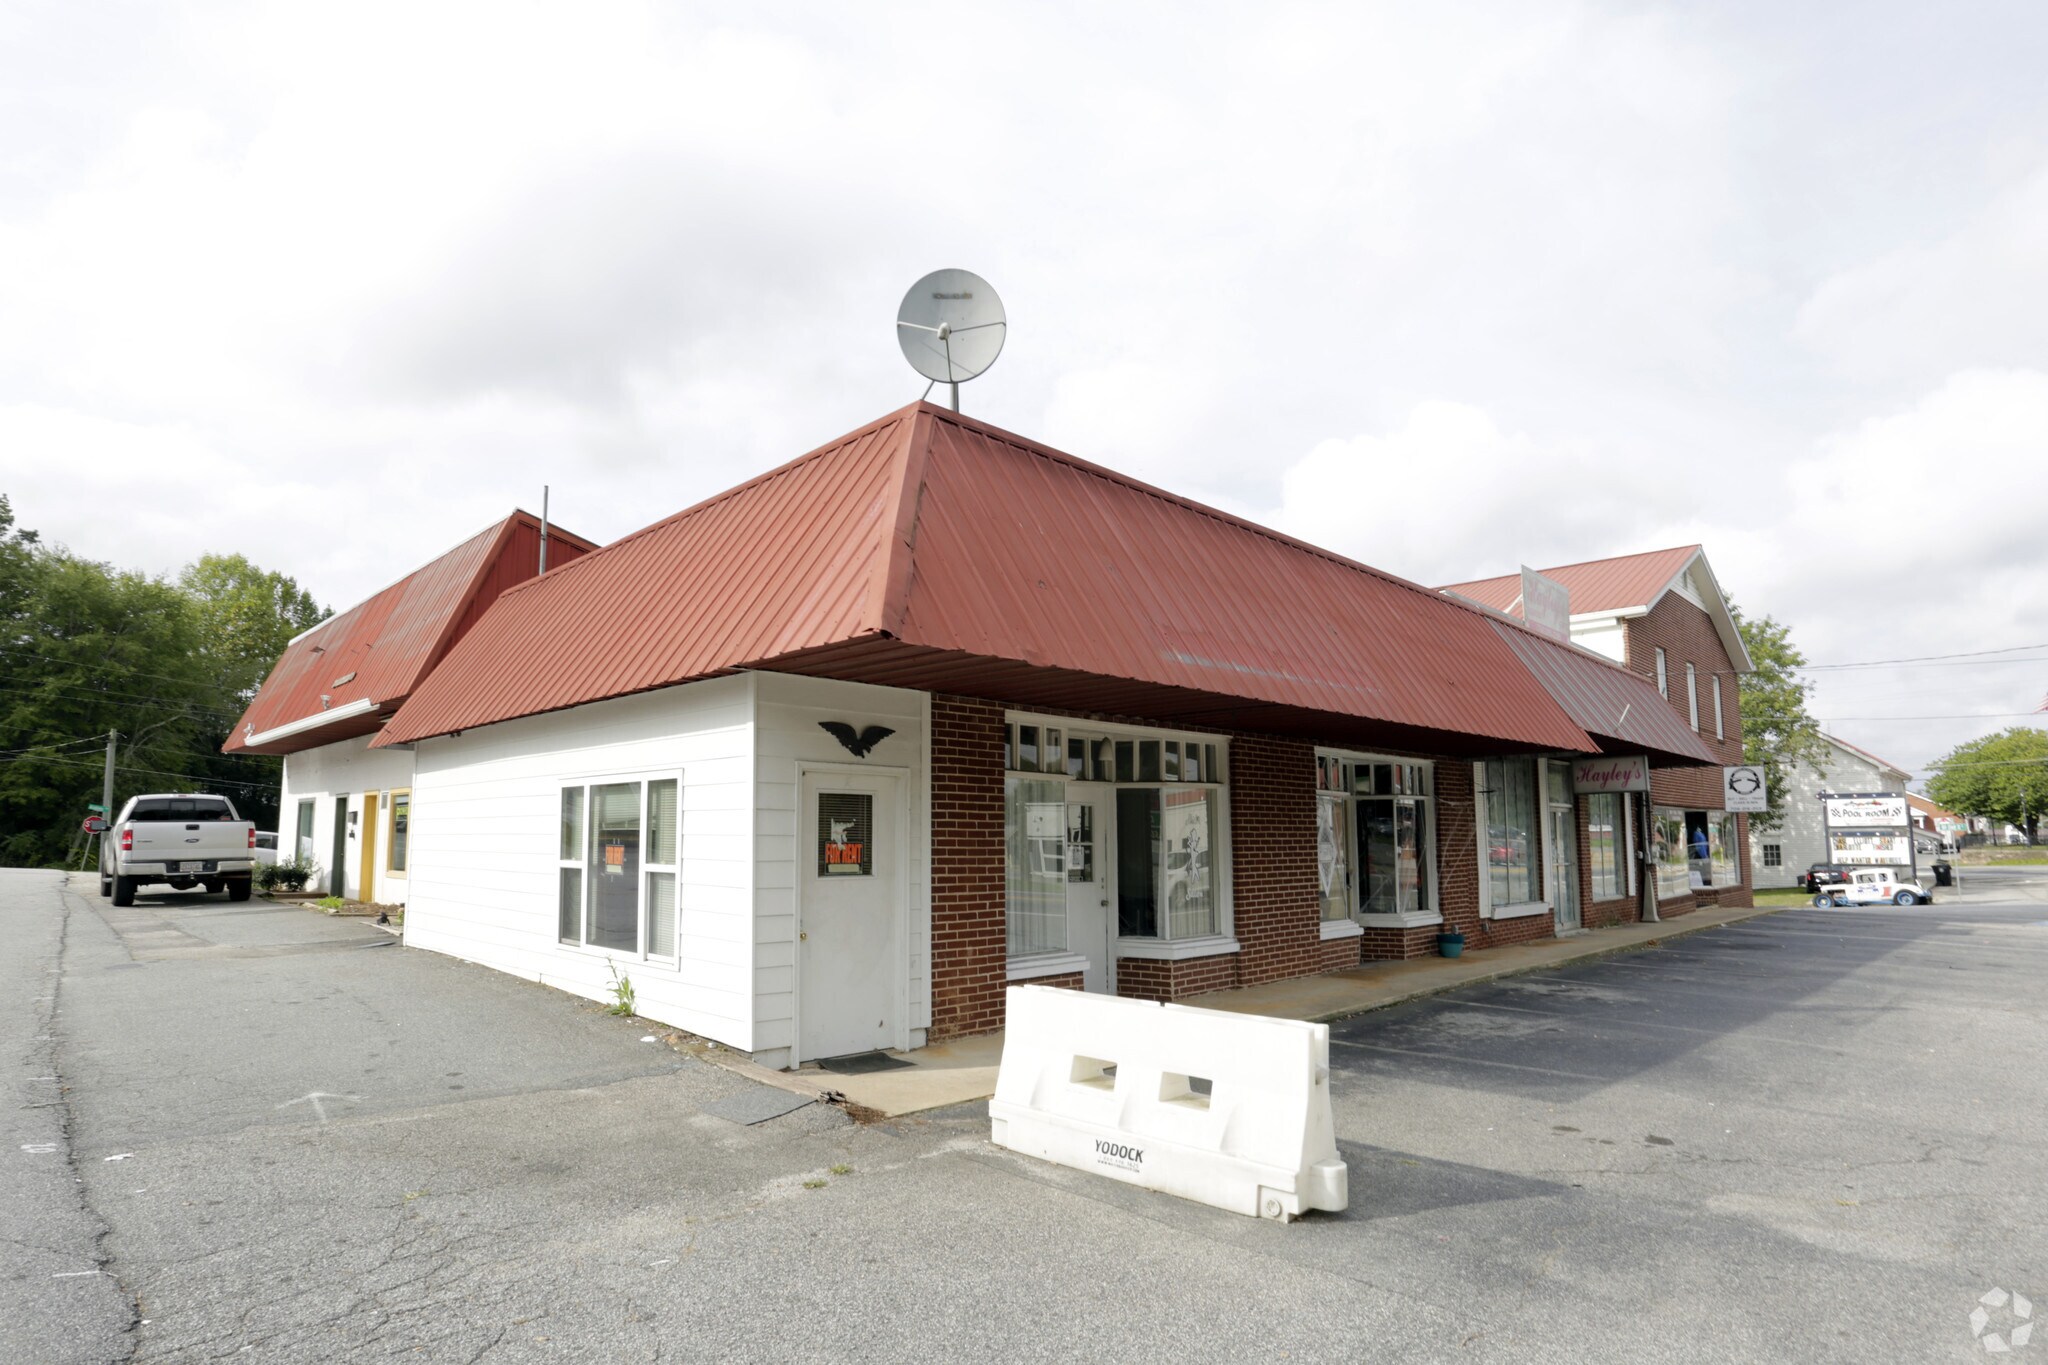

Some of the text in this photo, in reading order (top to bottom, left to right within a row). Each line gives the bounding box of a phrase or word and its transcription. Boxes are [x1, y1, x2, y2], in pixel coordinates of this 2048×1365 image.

[1576, 760, 1641, 789] Hayley's
[1842, 808, 1862, 817] POOL
[1865, 808, 1889, 817] ROOM
[825, 843, 862, 863] FOR RENT
[1095, 1139, 1144, 1164] YODOCK
